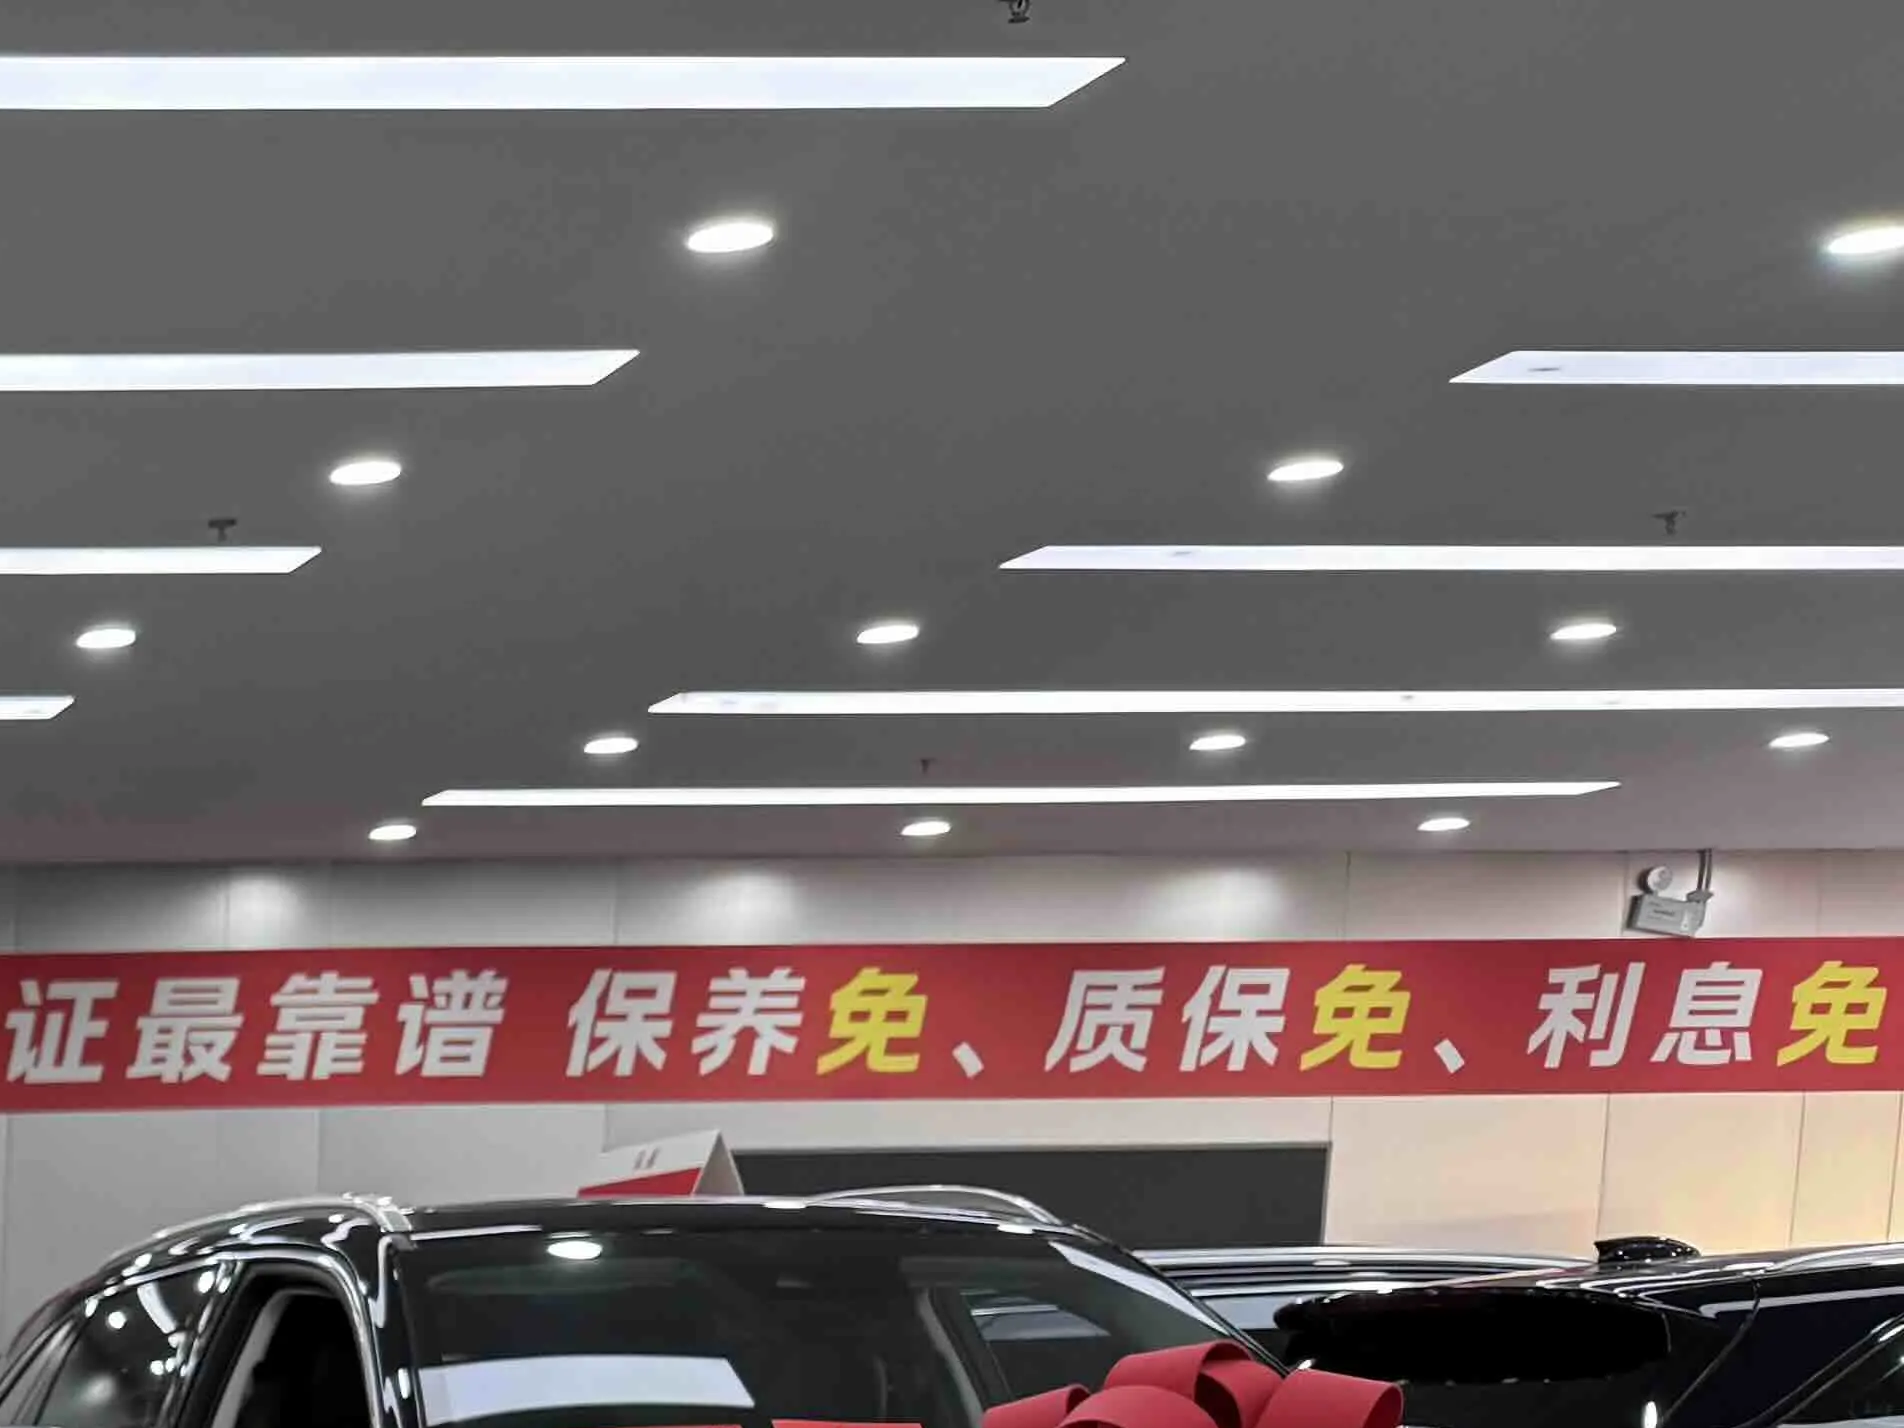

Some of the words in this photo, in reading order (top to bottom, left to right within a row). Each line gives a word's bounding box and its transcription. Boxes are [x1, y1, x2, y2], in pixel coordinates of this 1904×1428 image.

[565, 961, 1888, 1077] 保养免、质保免、利息免
